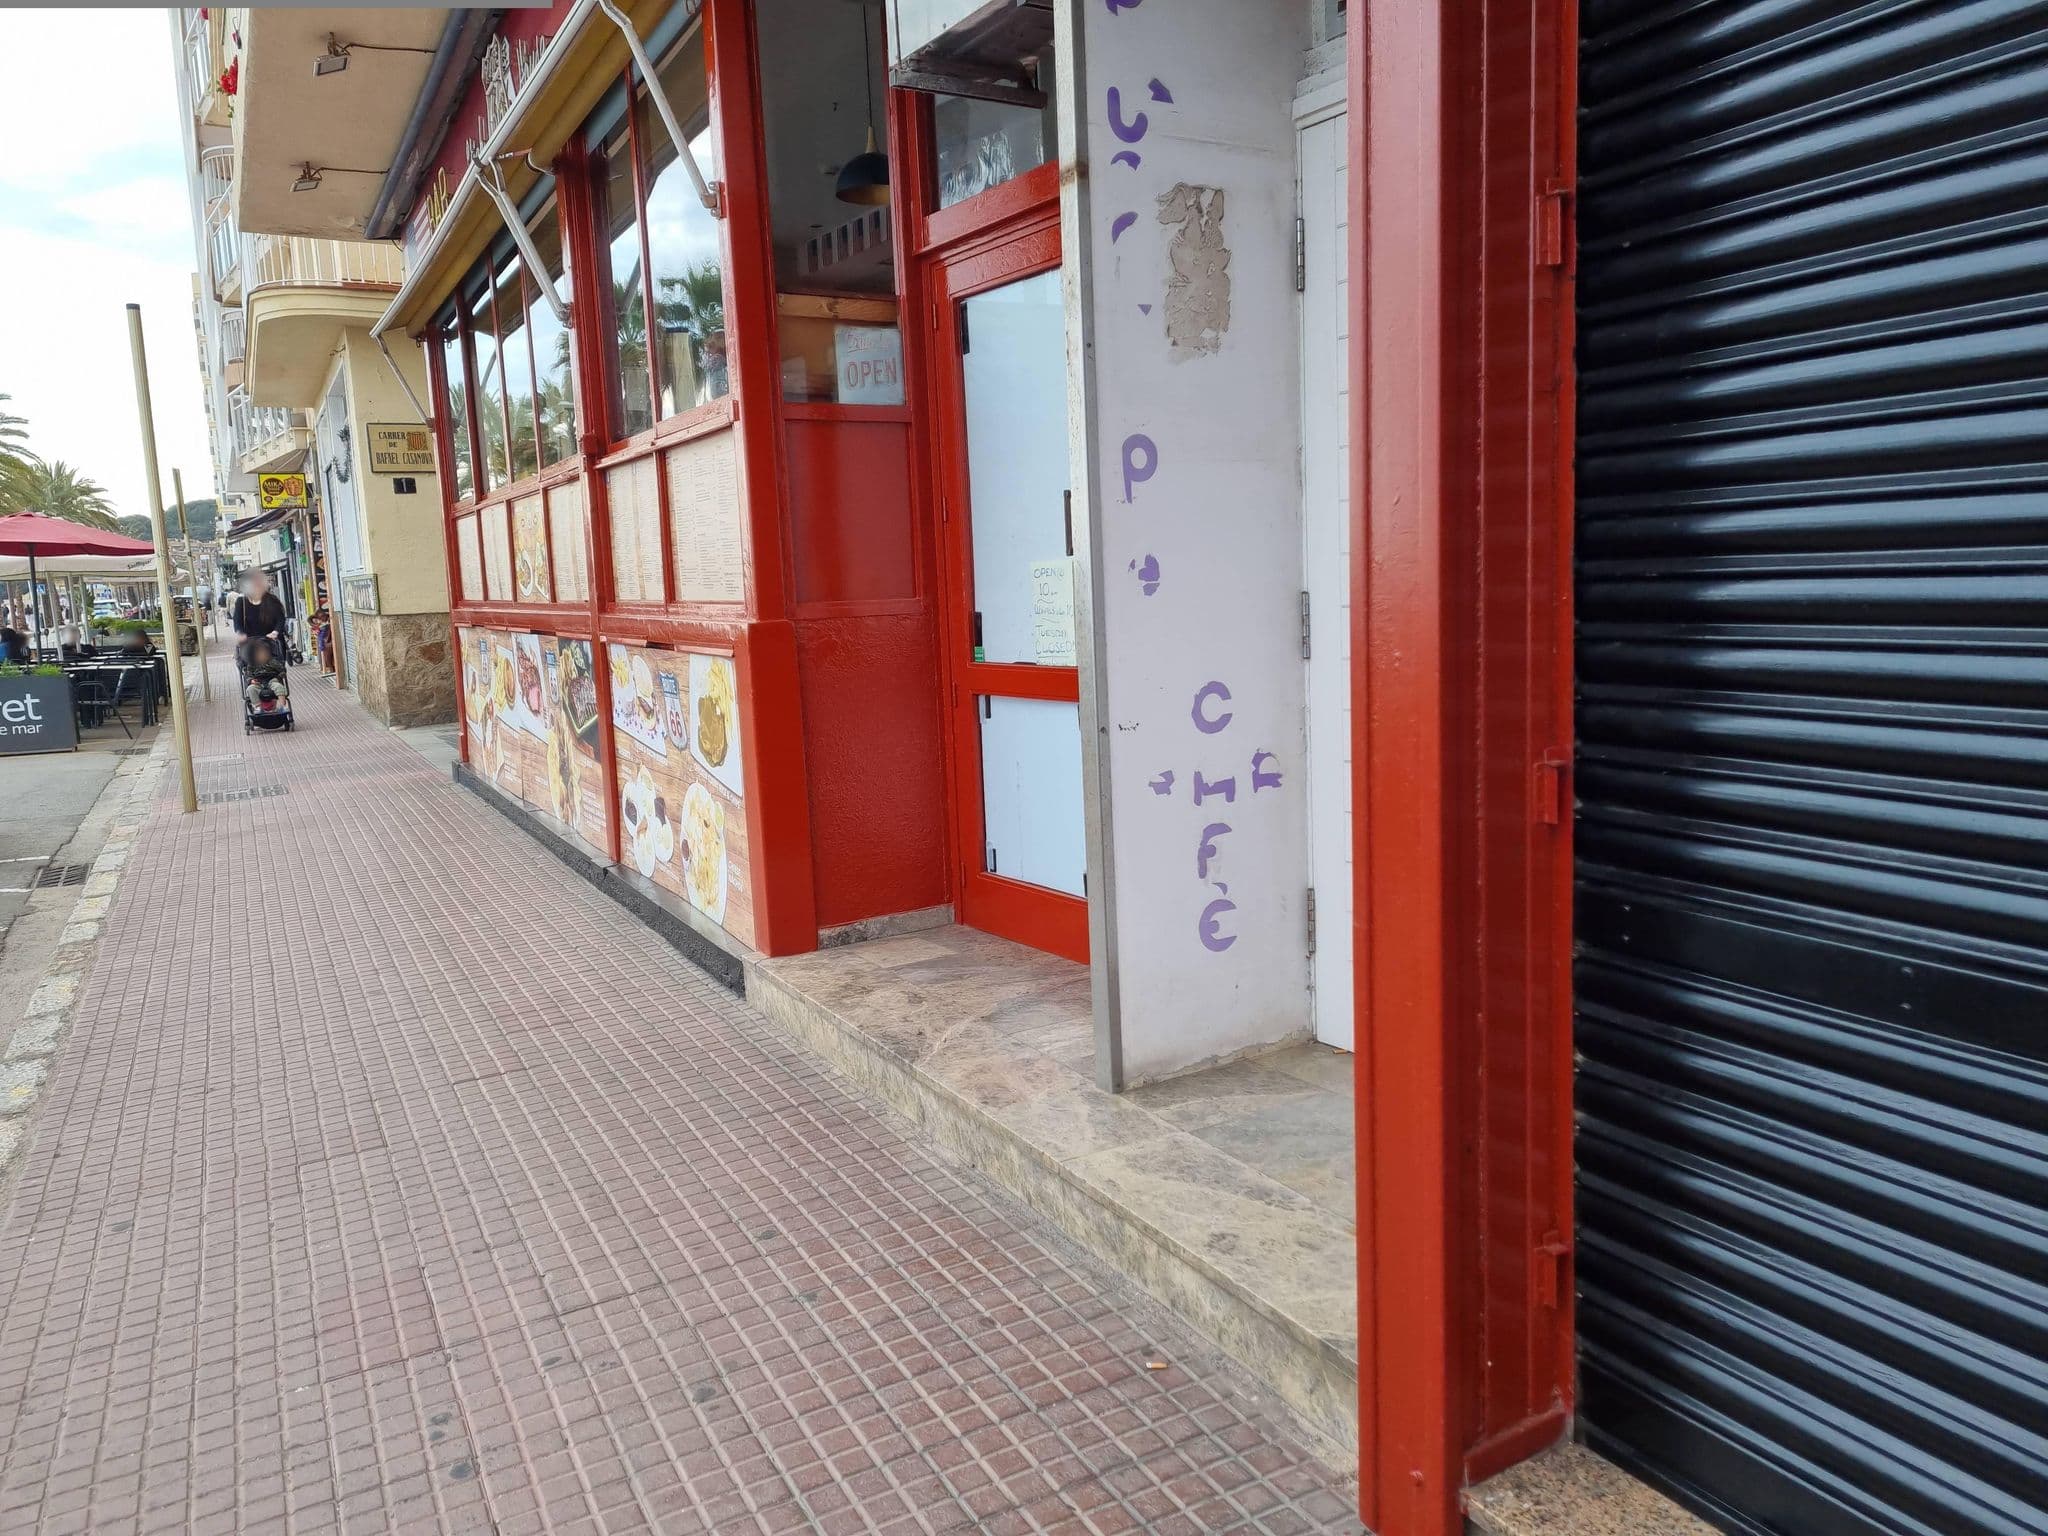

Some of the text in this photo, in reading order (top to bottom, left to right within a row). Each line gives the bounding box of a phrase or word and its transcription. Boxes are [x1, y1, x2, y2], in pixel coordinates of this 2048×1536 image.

[847, 357, 897, 388] OPEN
[378, 431, 406, 440] CARRER
[376, 452, 433, 465] RAFAEL CASANOVA
[0, 693, 42, 722] et
[12, 724, 43, 735] mar
[670, 710, 683, 738] 66
